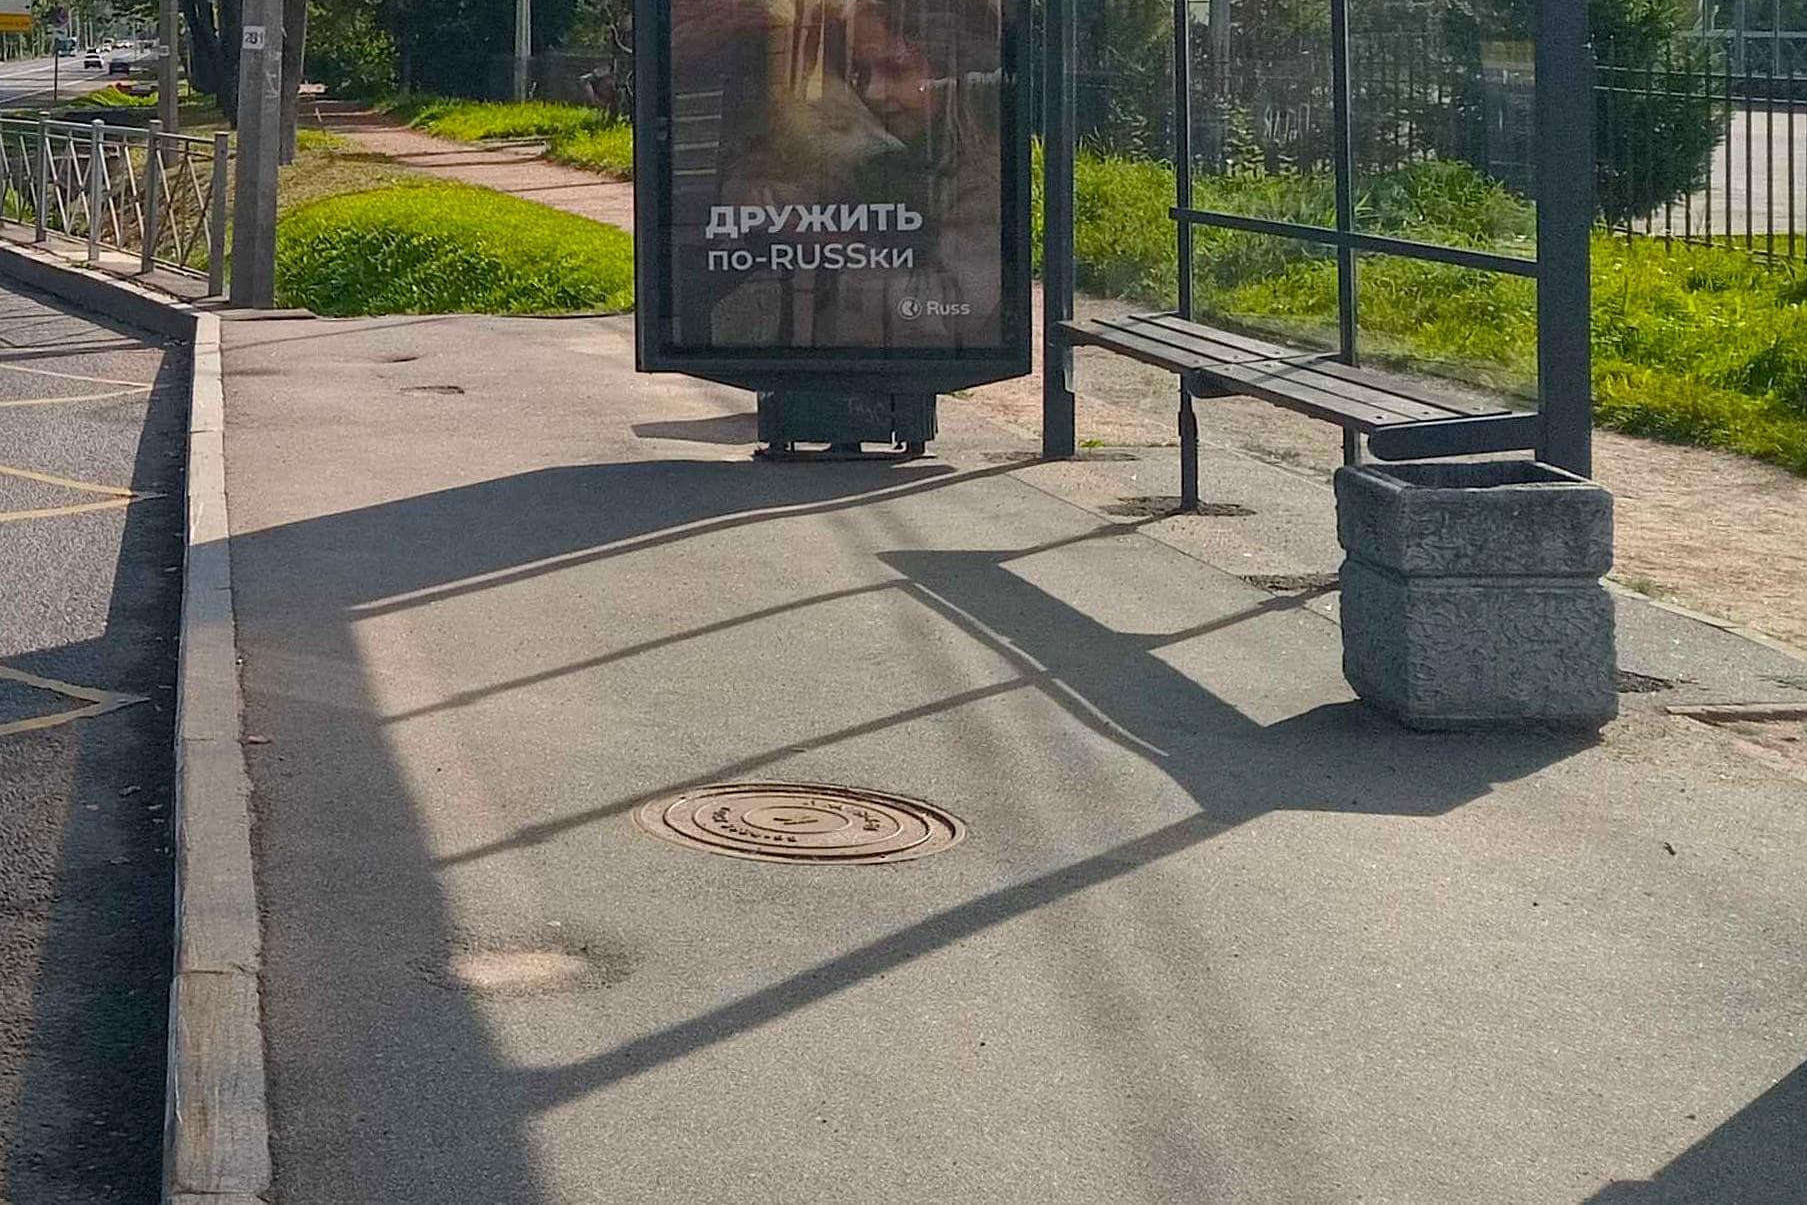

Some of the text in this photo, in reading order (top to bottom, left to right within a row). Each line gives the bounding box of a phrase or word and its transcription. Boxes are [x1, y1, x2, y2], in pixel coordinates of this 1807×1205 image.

[705, 203, 923, 239] ДРУЖИТЬ
[708, 243, 914, 271] по-RUSSки
[926, 301, 971, 316] Russ
